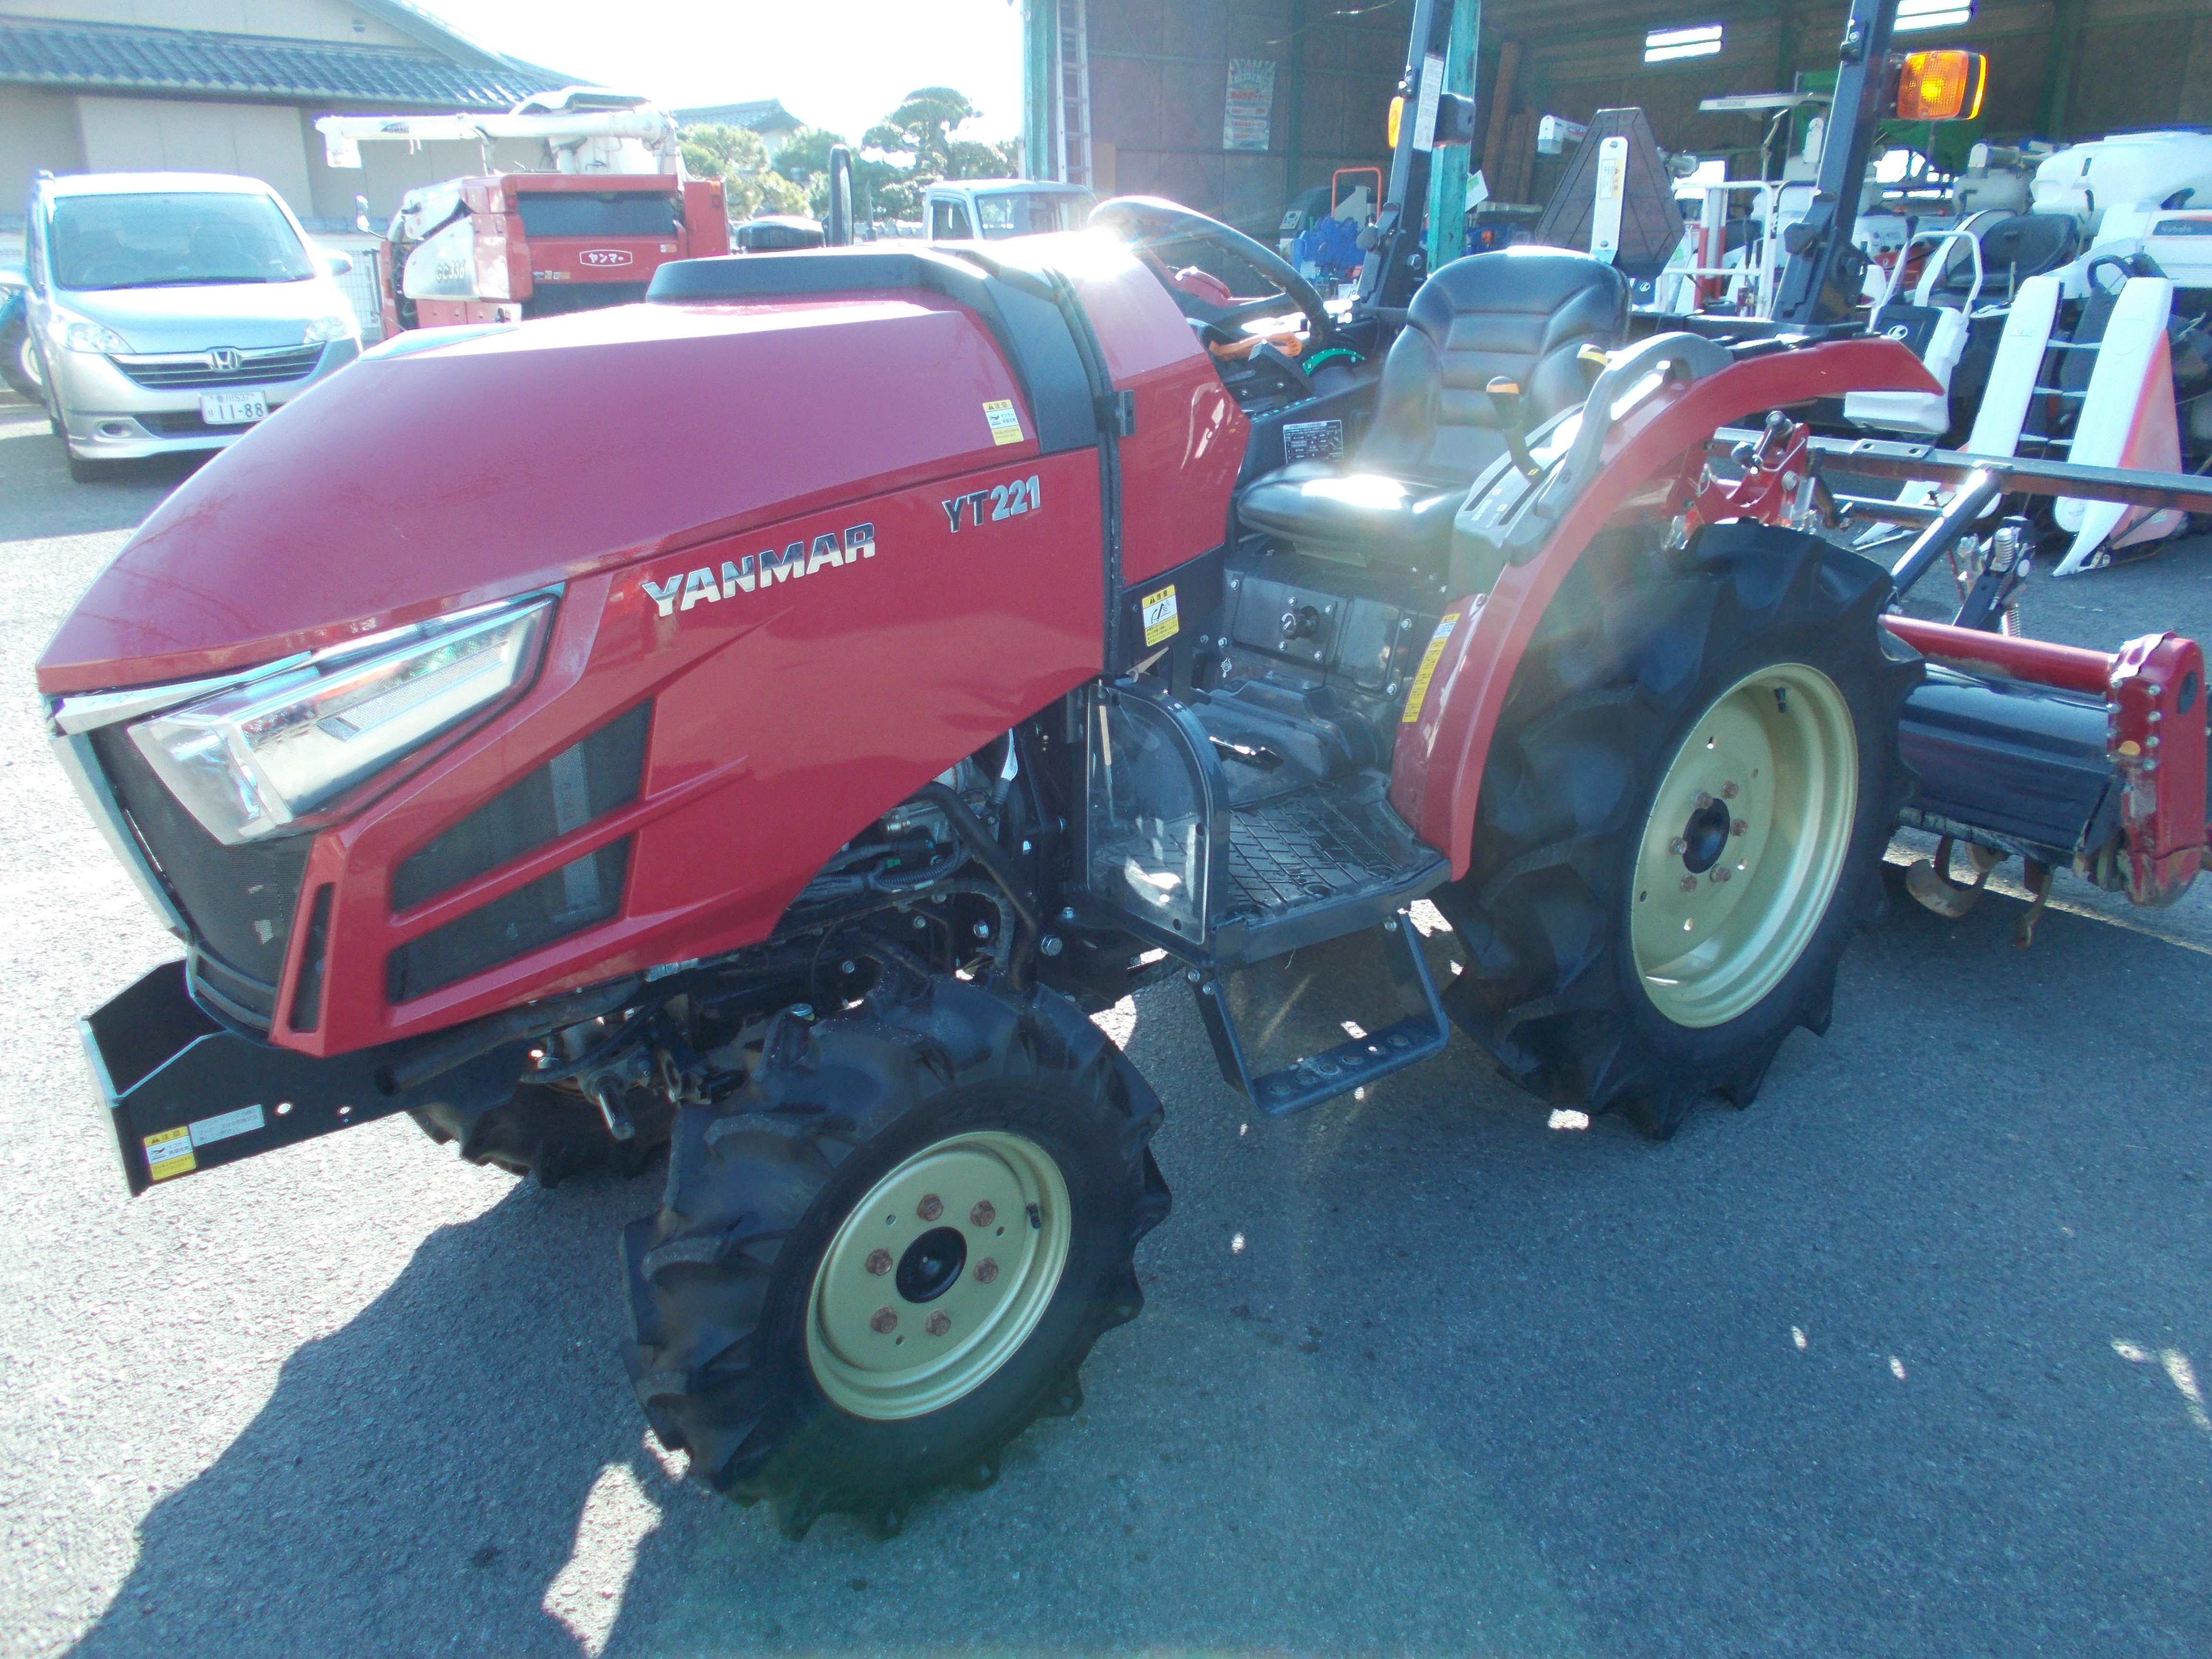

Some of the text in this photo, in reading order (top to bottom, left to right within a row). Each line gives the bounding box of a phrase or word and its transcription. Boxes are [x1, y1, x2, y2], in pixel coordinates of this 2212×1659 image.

[589, 252, 624, 263] ヤンマー
[435, 259, 465, 280] GC336
[219, 403, 264, 419] 11-88
[941, 475, 1040, 533] YT221
[642, 523, 876, 617] YANMAR
[1156, 589, 1168, 601] 注意
[162, 1130, 180, 1140] 注意
